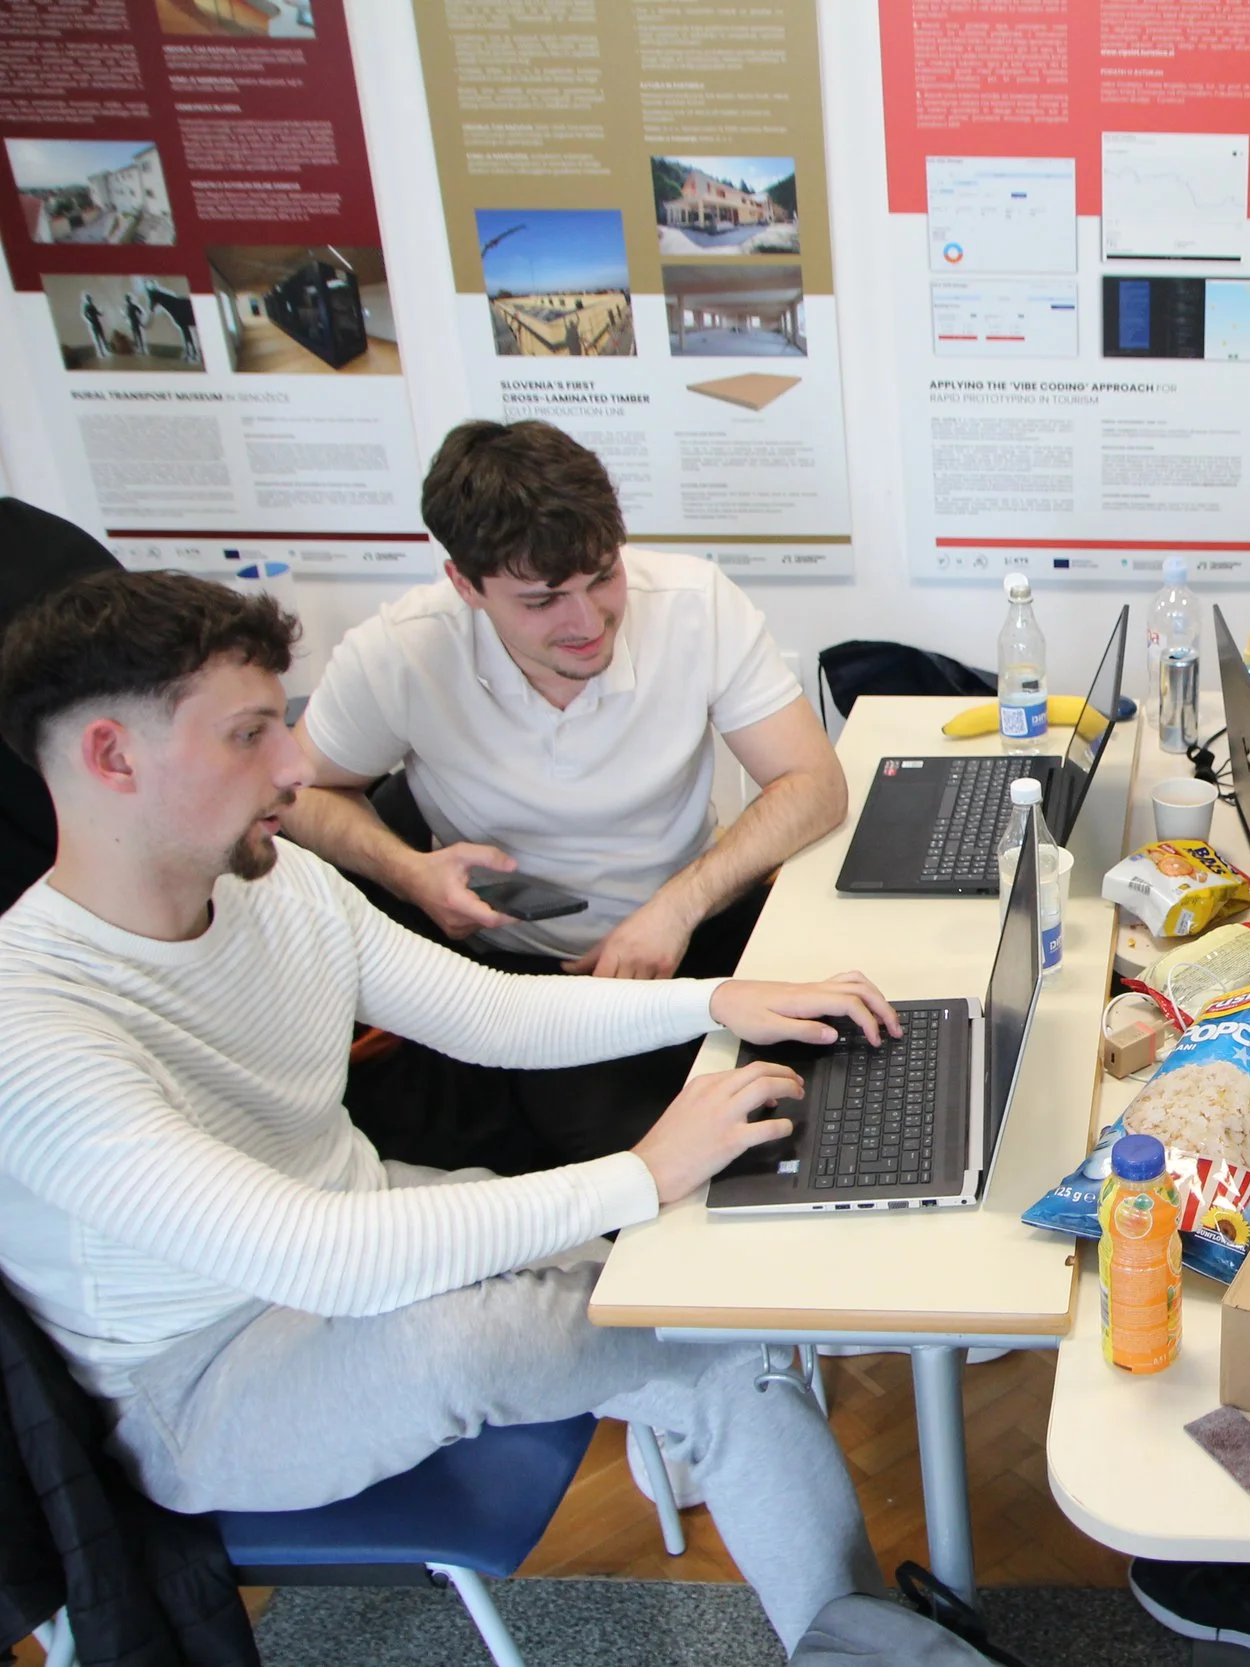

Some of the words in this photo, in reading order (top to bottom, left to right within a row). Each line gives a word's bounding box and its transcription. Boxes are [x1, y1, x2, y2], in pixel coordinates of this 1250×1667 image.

[566, 381, 595, 391] FIRST
[929, 380, 984, 391] APPLYING
[986, 380, 1007, 391] THE
[1092, 381, 1154, 393] APPROACH
[611, 394, 651, 404] TIMBER
[1053, 1187, 1073, 1197] 125
[1072, 1191, 1083, 1202] g
